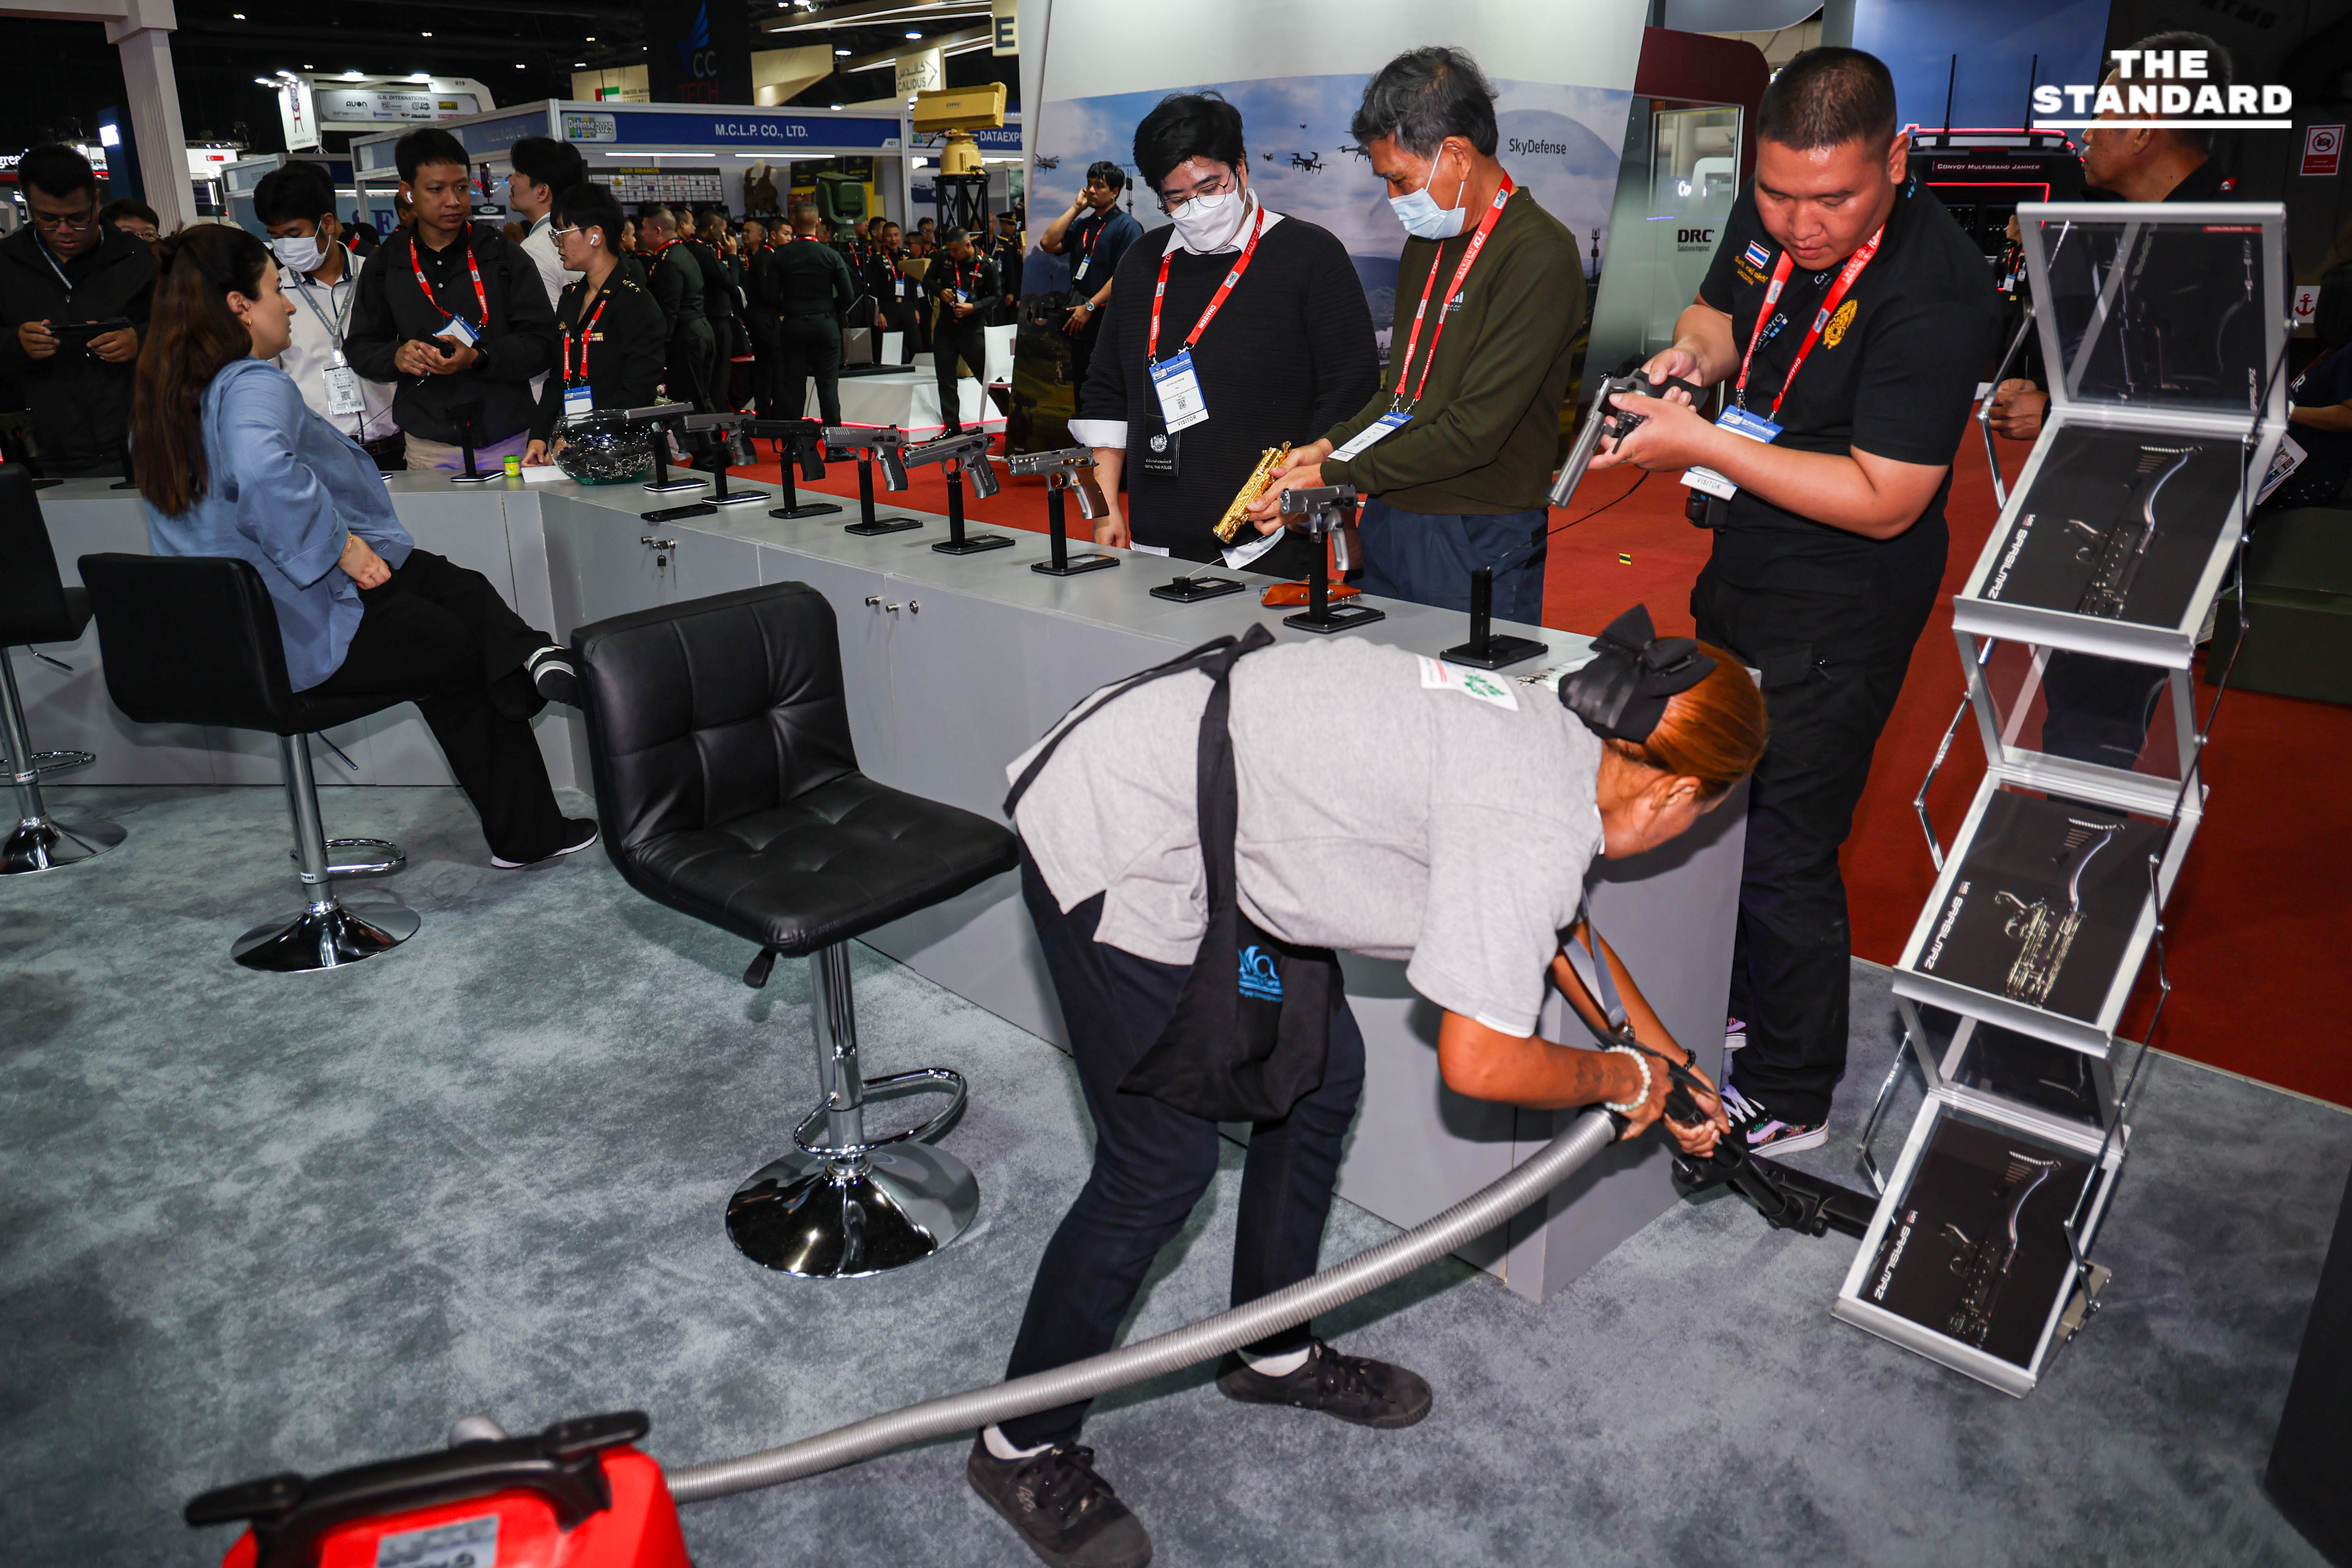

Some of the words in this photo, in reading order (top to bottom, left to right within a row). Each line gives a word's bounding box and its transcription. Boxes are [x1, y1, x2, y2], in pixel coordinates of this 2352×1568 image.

[693, 50, 717, 78] CC
[896, 77, 926, 92] CALIDUS
[568, 119, 594, 129] Defense
[595, 121, 613, 133] 2025
[715, 124, 758, 136] M.C.L.P.
[761, 124, 783, 138] CO.,
[786, 125, 808, 137] LTD.
[1509, 138, 1566, 155] SkyDefense
[1473, 231, 1486, 249] TDI
[1456, 248, 1474, 279] INDUSTRY
[1459, 260, 1472, 280] DEFENSE
[1841, 246, 1867, 281] INDUSTRY
[1846, 260, 1864, 284] DEFENSE
[1198, 304, 1217, 329] CHAISERI
[1403, 343, 1414, 375] CHAISERI
[1421, 349, 1433, 381] CHAISERI
[1784, 358, 1801, 392] CHAISERI
[1177, 415, 1197, 426] VISITOR
[1697, 477, 1721, 489] VISITOR
[1988, 528, 2028, 600] SARSILMAZ
[1924, 896, 1963, 970] SARSILMAZ
[1873, 1225, 1911, 1300] SARSILMAZ
